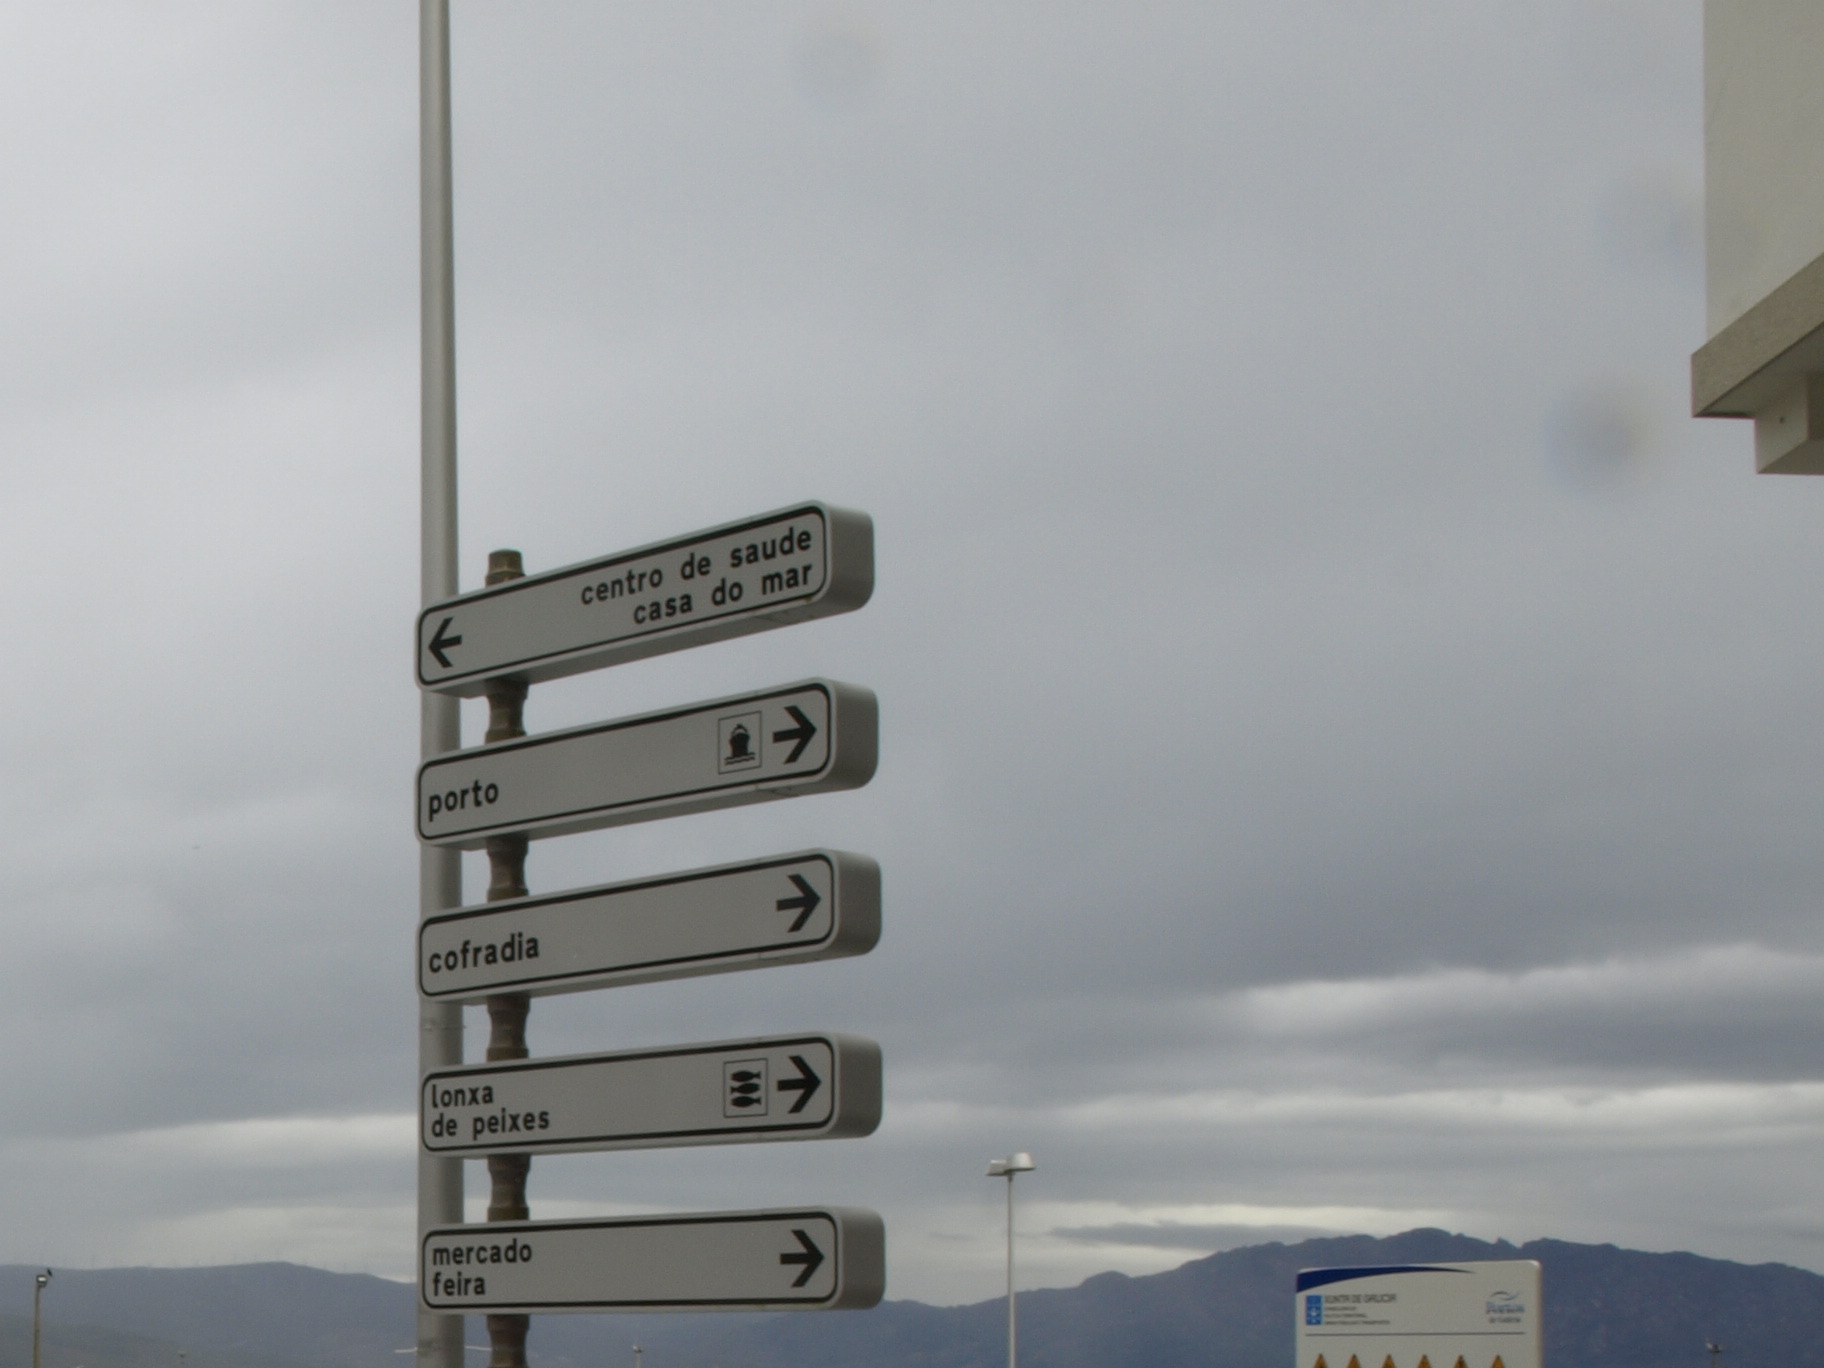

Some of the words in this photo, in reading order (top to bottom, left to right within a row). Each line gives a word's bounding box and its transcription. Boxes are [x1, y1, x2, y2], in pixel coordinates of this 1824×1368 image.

[581, 569, 663, 605] centro
[680, 552, 711, 579] de
[730, 526, 812, 567] saude
[634, 594, 693, 624] casa
[712, 578, 743, 606] do
[761, 561, 813, 594] mar
[428, 779, 499, 822] porto
[429, 932, 540, 973] cofradia
[431, 1084, 494, 1108] lonxa
[431, 1112, 458, 1137] de
[472, 1108, 550, 1140] peixes
[432, 1239, 532, 1266] mercado
[432, 1272, 486, 1296] feira
